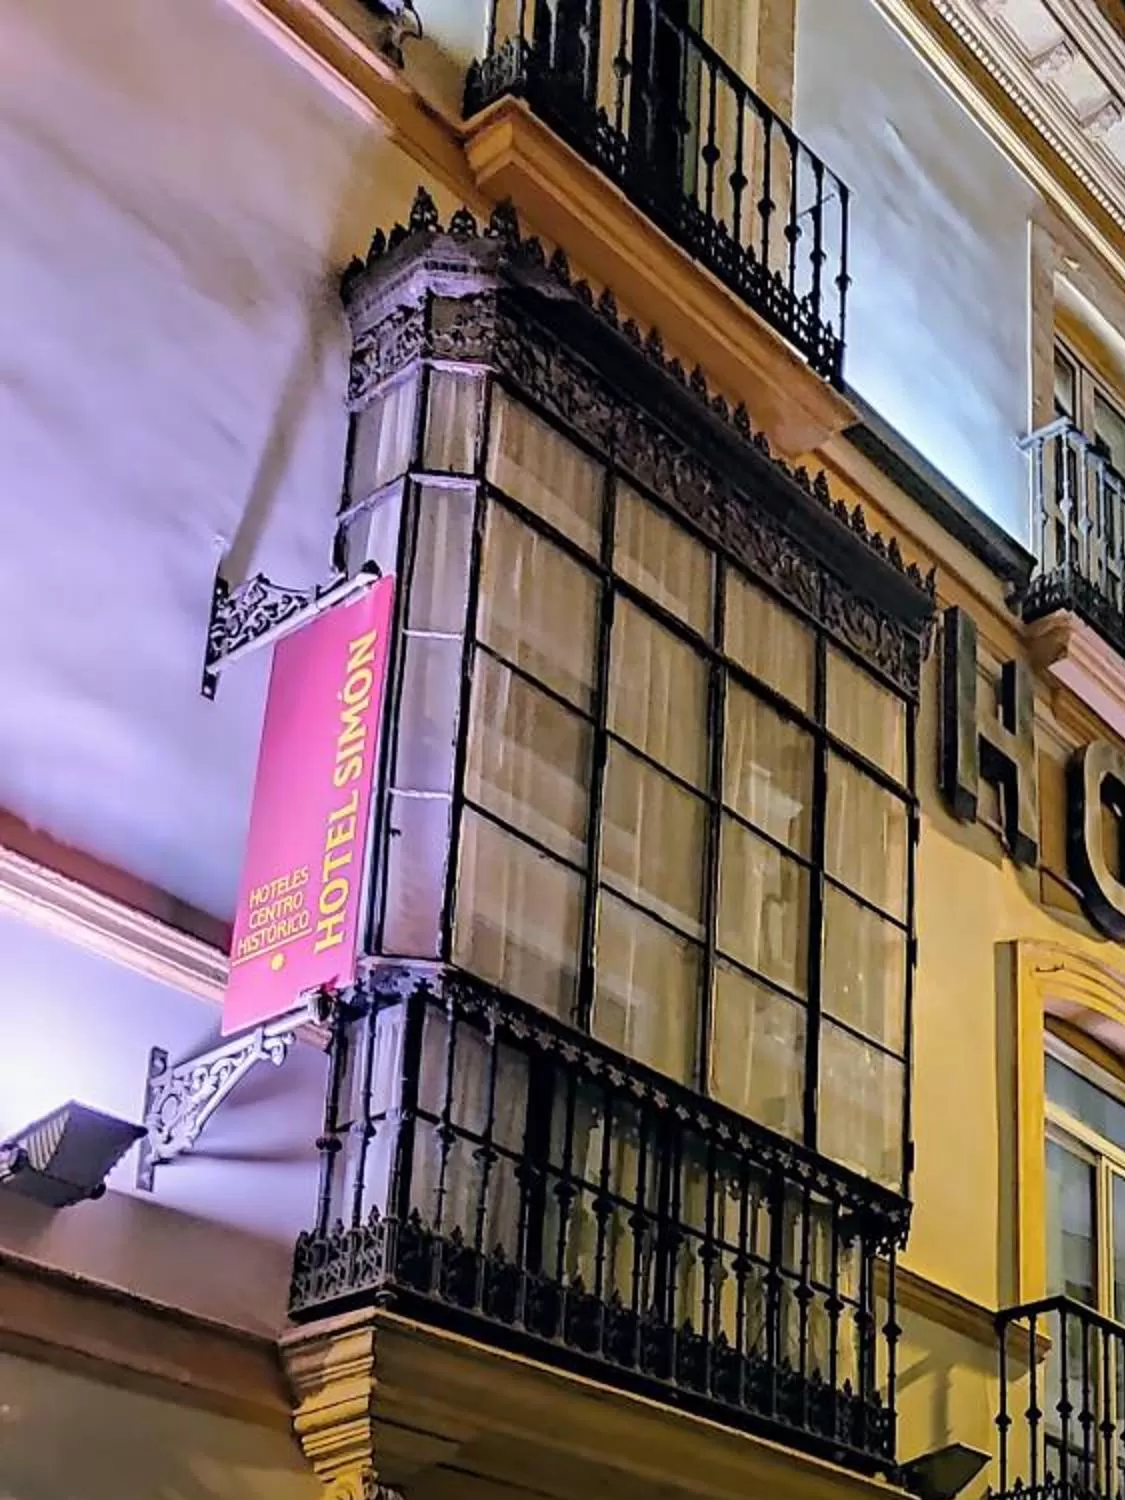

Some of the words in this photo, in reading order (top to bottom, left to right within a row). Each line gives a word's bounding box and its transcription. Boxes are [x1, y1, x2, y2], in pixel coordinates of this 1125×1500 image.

[333, 628, 377, 787] SIMÓN
[249, 865, 309, 910] HOTELES
[249, 891, 303, 929] CENTRO
[314, 789, 359, 953] HOTEL
